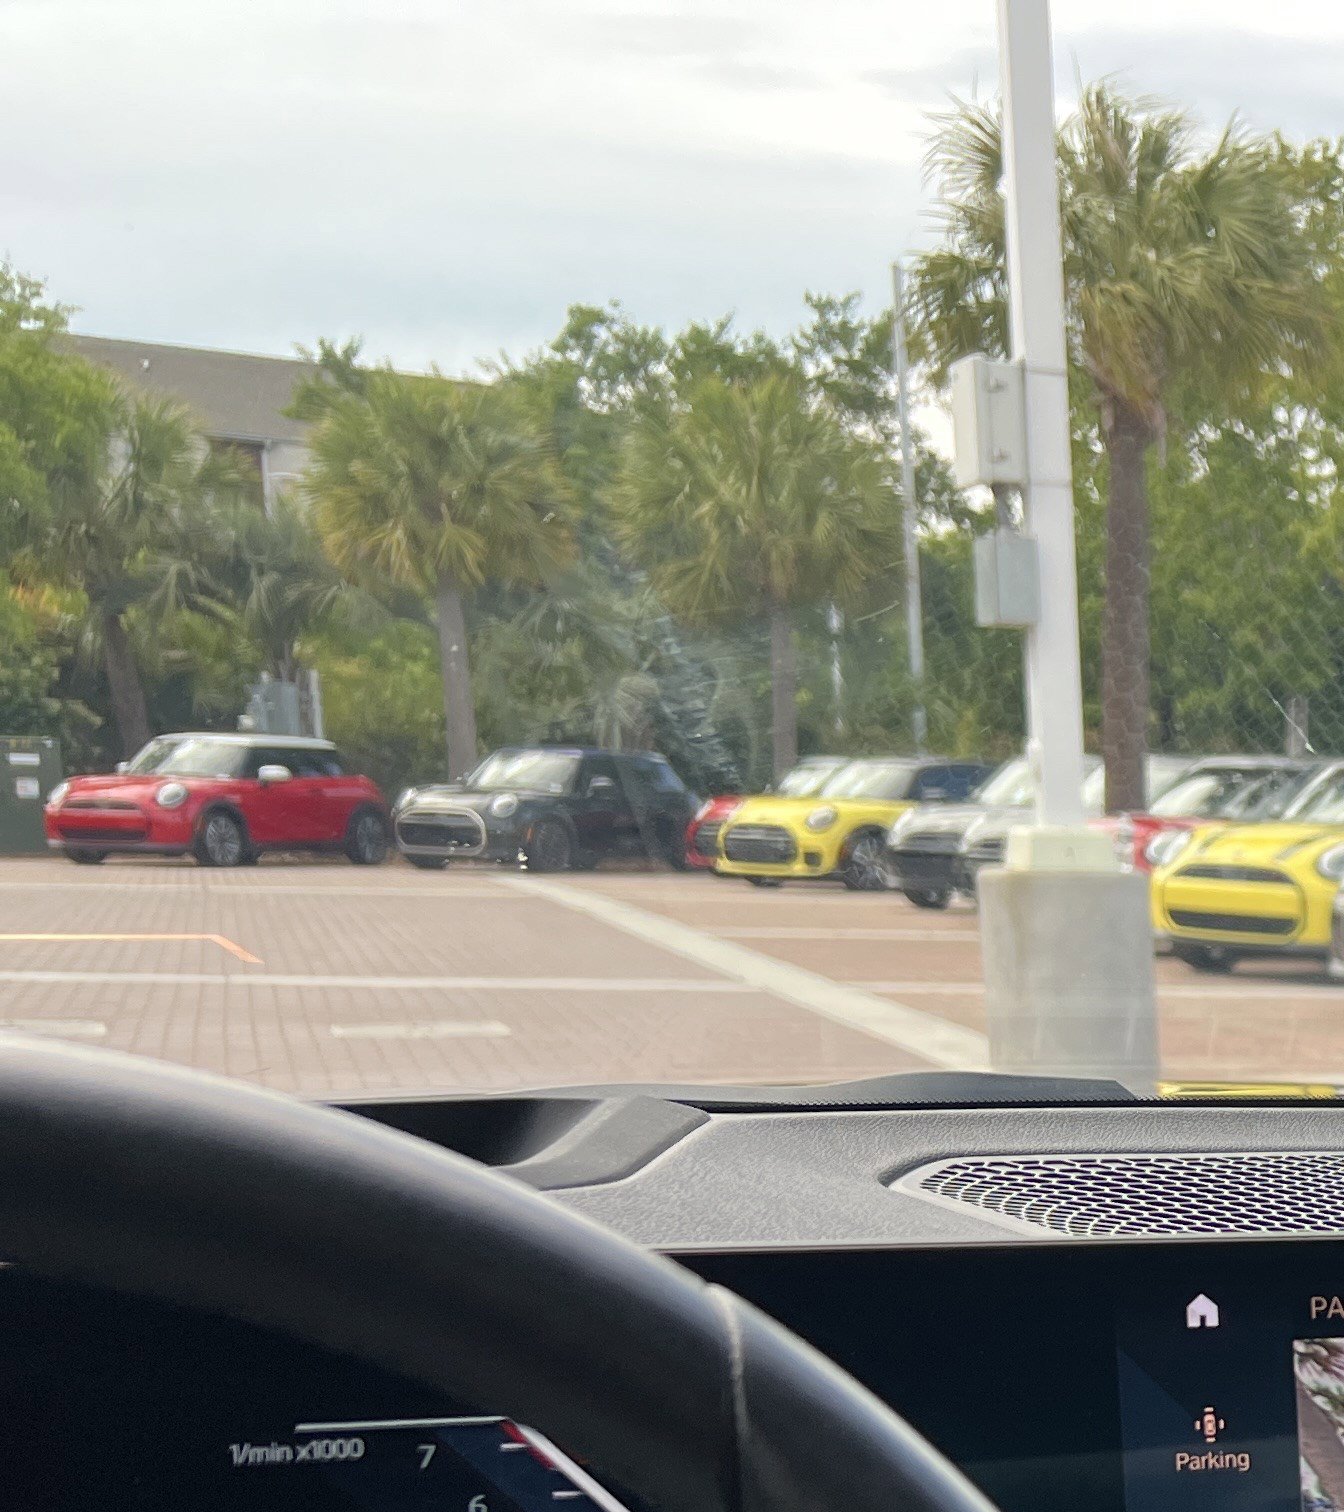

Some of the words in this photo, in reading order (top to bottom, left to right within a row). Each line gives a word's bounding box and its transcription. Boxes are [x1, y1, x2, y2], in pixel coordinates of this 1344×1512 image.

[229, 1442, 293, 1467] 1/min
[296, 1437, 365, 1462] x1000
[417, 1444, 437, 1470] 7
[1175, 1451, 1250, 1472] Parking
